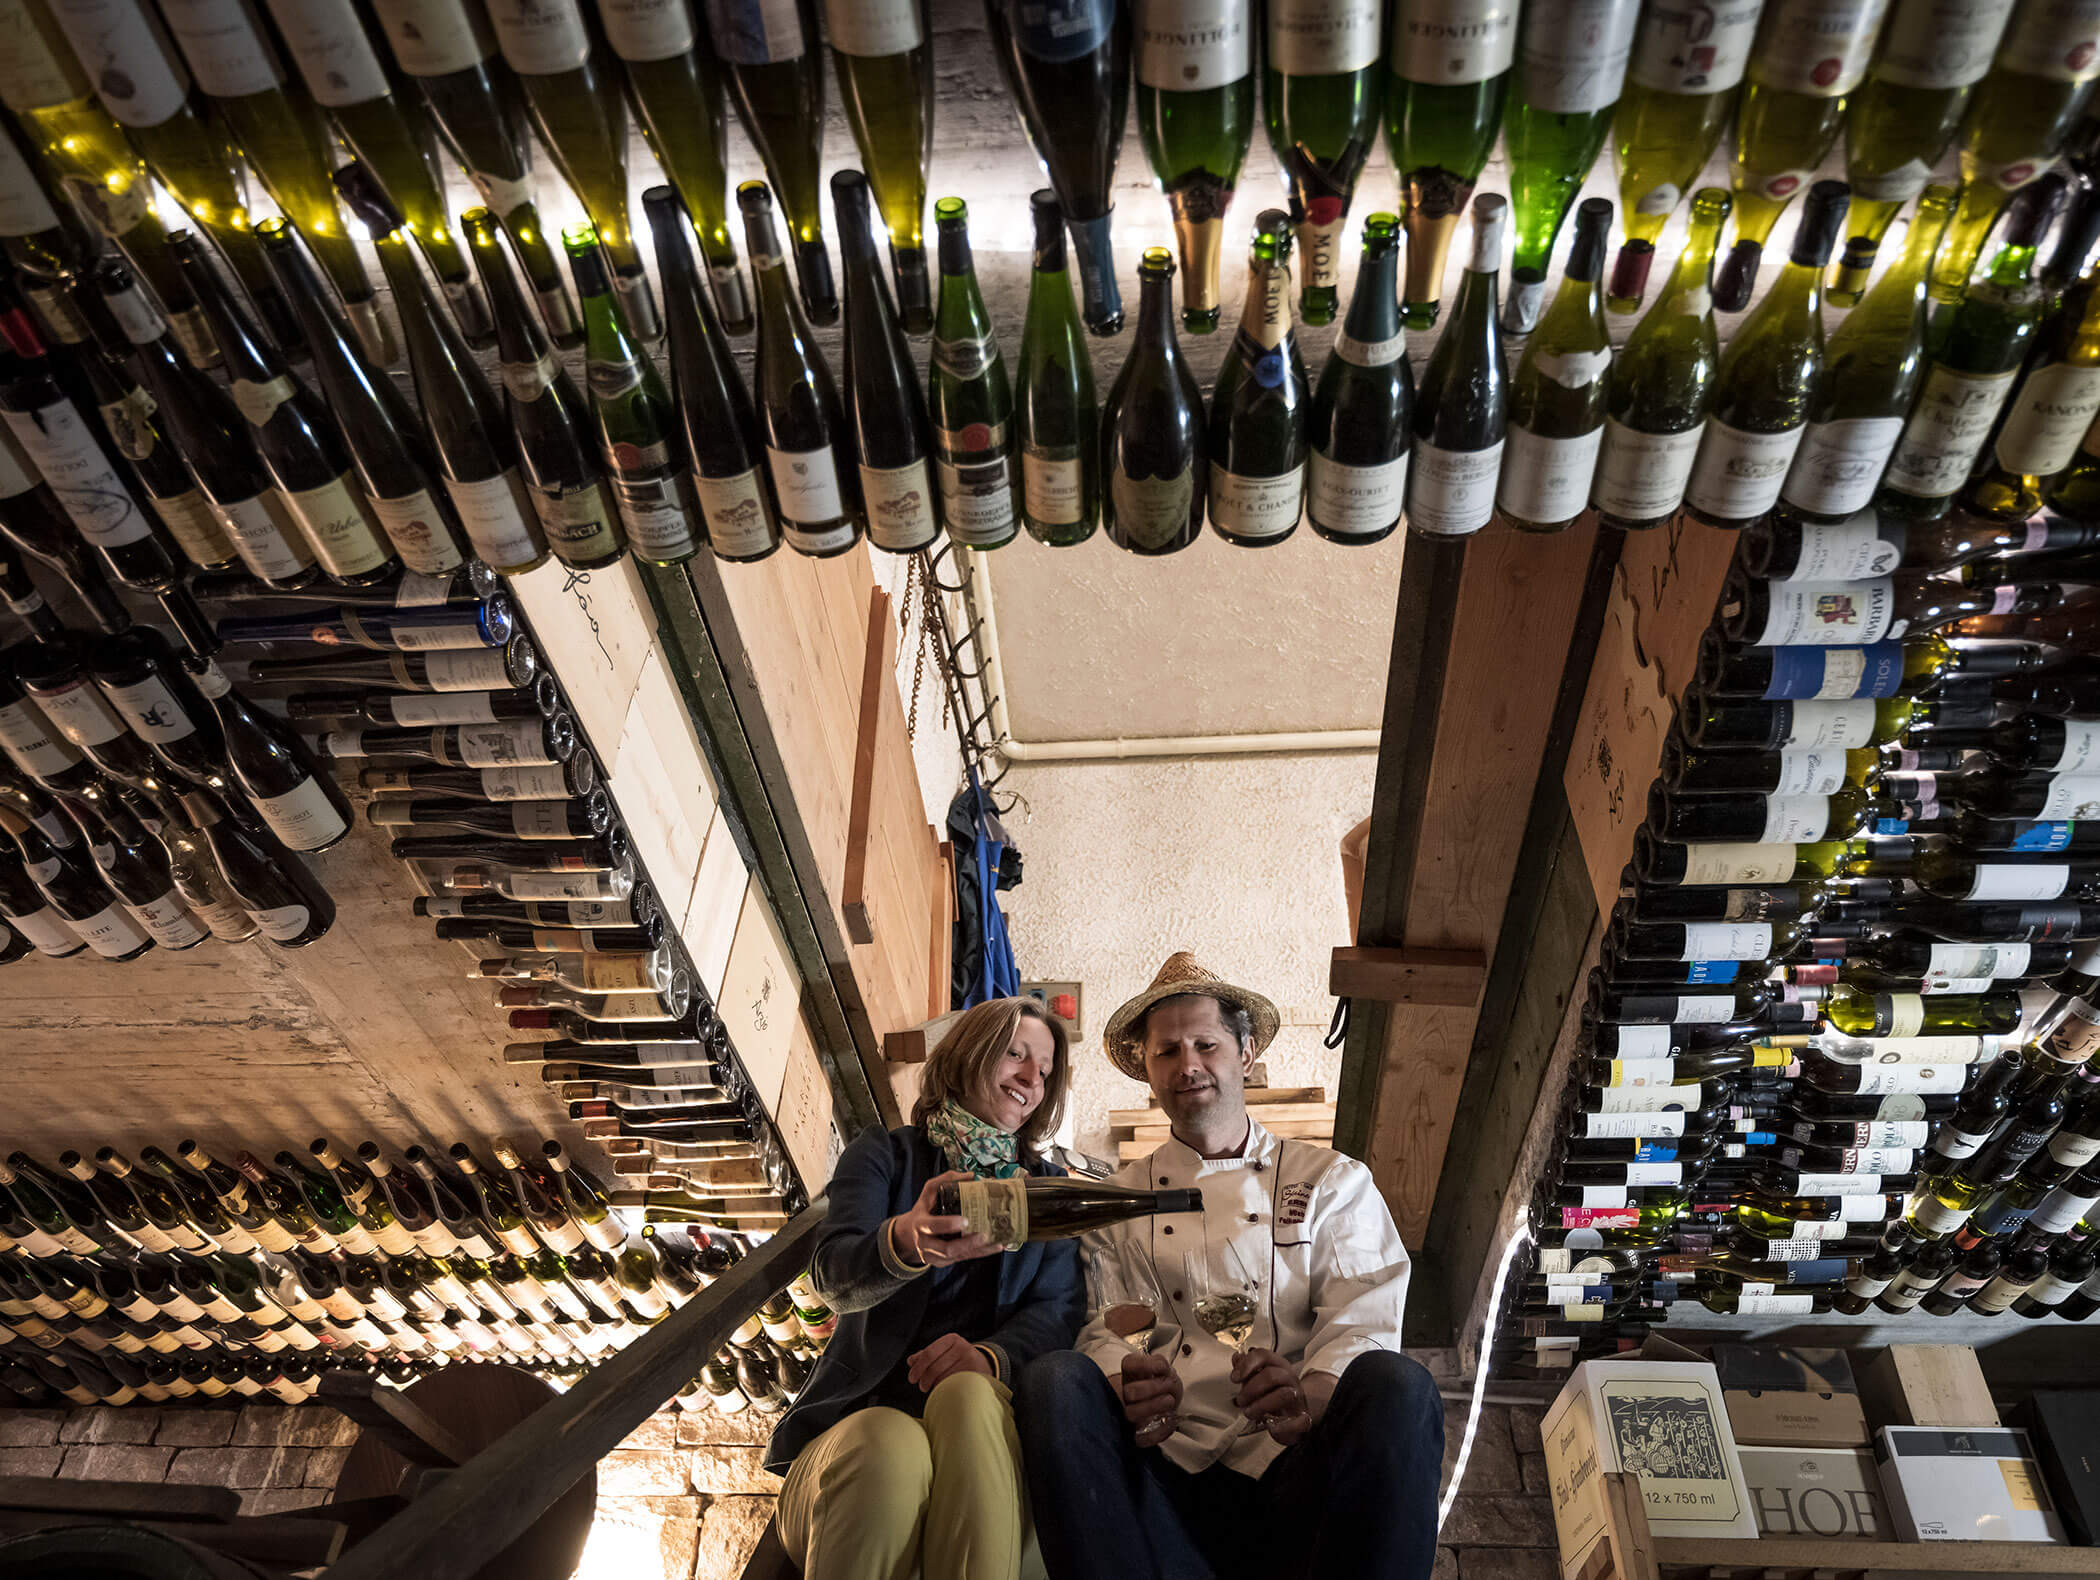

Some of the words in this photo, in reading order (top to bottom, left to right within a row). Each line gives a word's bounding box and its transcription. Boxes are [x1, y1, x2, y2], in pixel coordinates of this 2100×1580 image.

[1645, 1492, 1661, 1504] 12
[1664, 1494, 1672, 1504] x
[1674, 1492, 1697, 1505] 750
[1700, 1494, 1716, 1505] ml
[1749, 1487, 1878, 1538] HOF
